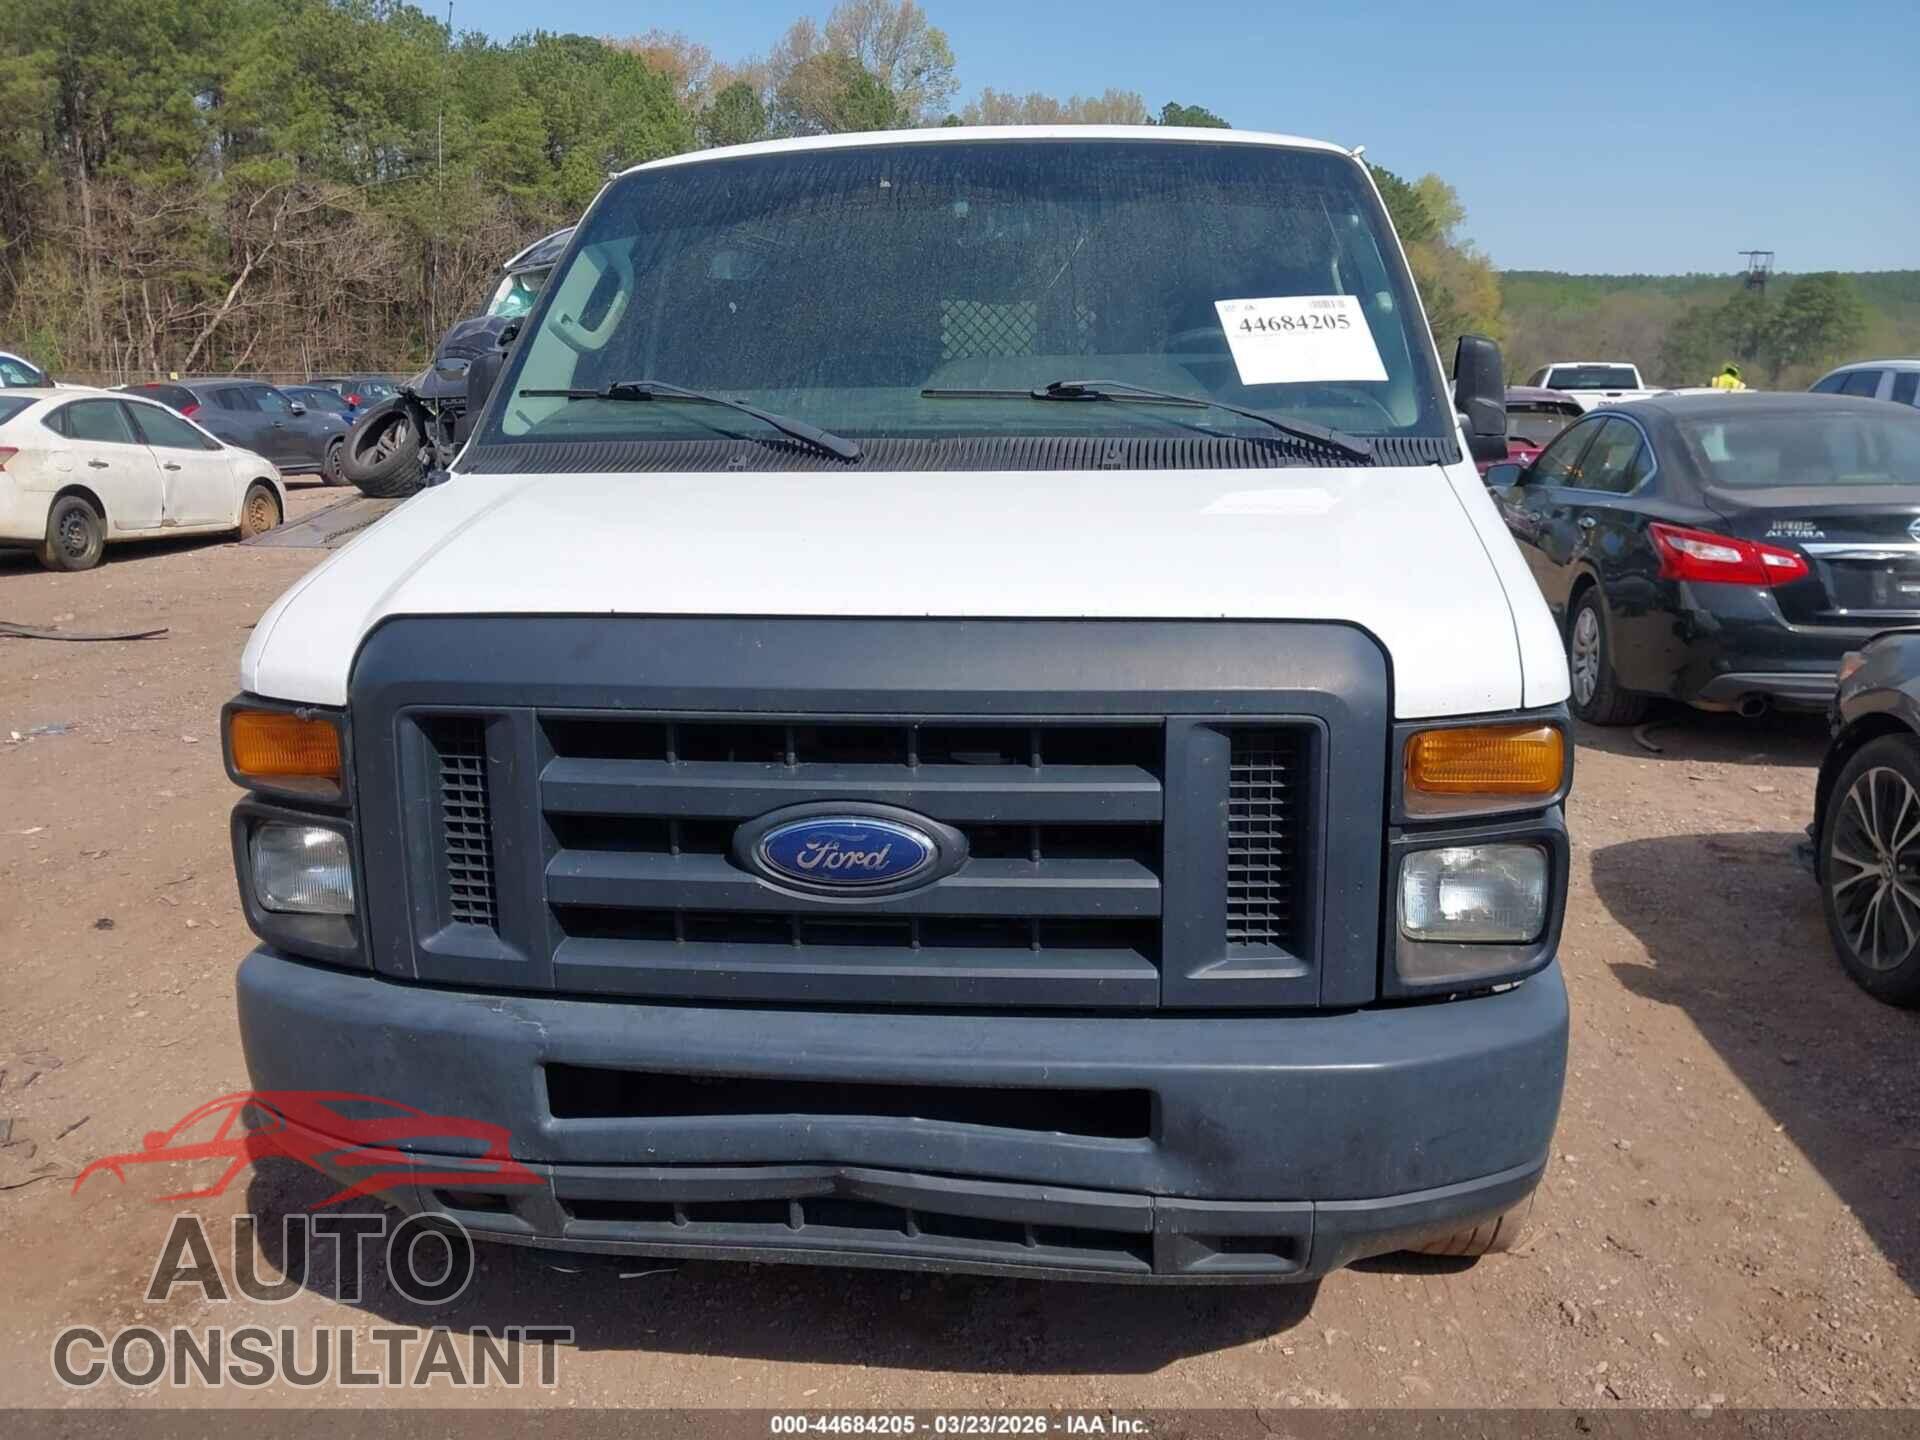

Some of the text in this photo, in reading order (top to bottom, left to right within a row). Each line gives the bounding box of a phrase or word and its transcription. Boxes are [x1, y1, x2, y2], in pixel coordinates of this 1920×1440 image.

[1239, 313, 1351, 332] 44684205
[1765, 530, 1826, 538] ALTIMA
[796, 840, 890, 869] Ford
